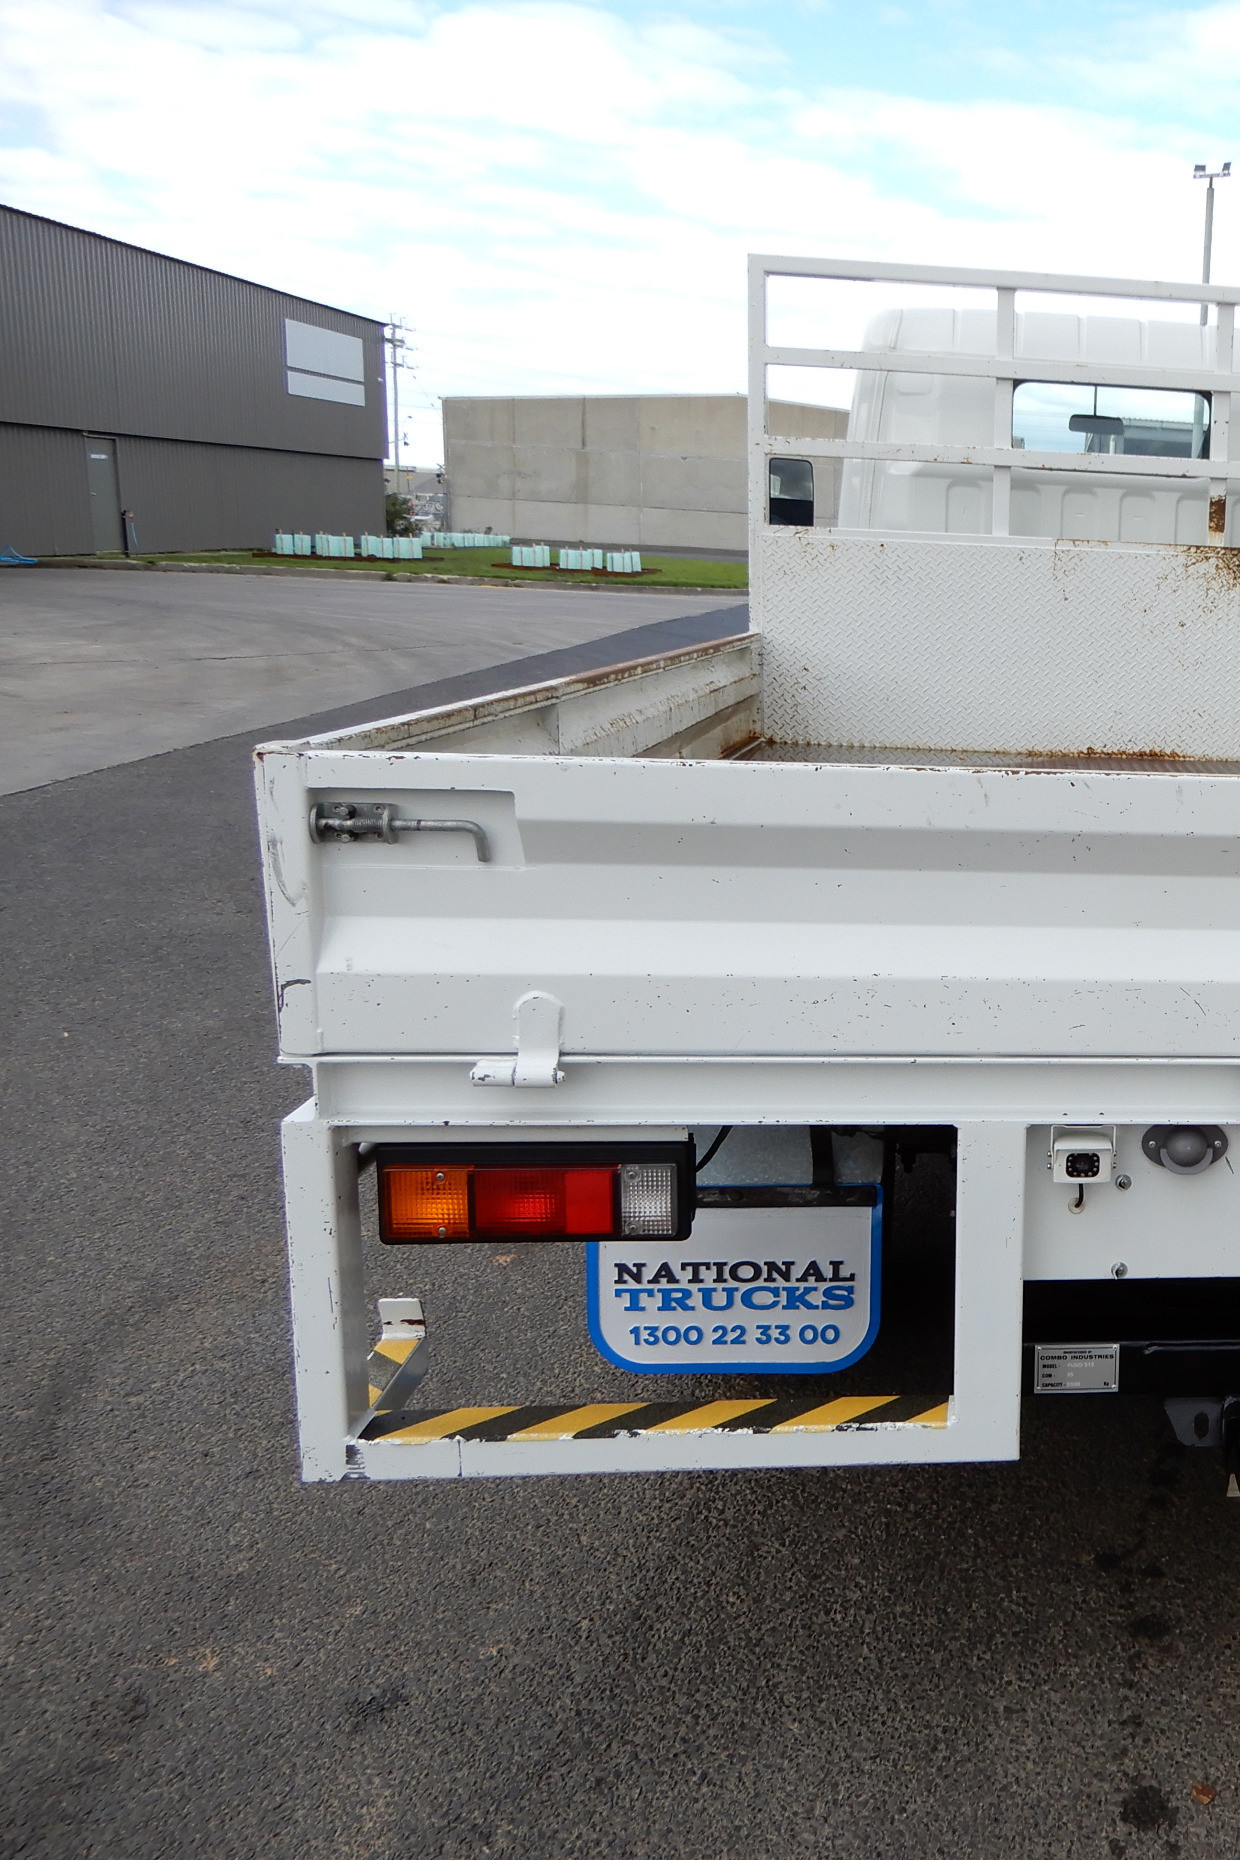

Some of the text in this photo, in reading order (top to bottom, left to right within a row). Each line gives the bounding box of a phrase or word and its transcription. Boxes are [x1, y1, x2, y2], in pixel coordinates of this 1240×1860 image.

[613, 1260, 855, 1284] NATIONAL
[614, 1285, 855, 1311] TRUCKS
[629, 1324, 841, 1346] 1300 22 33 00
